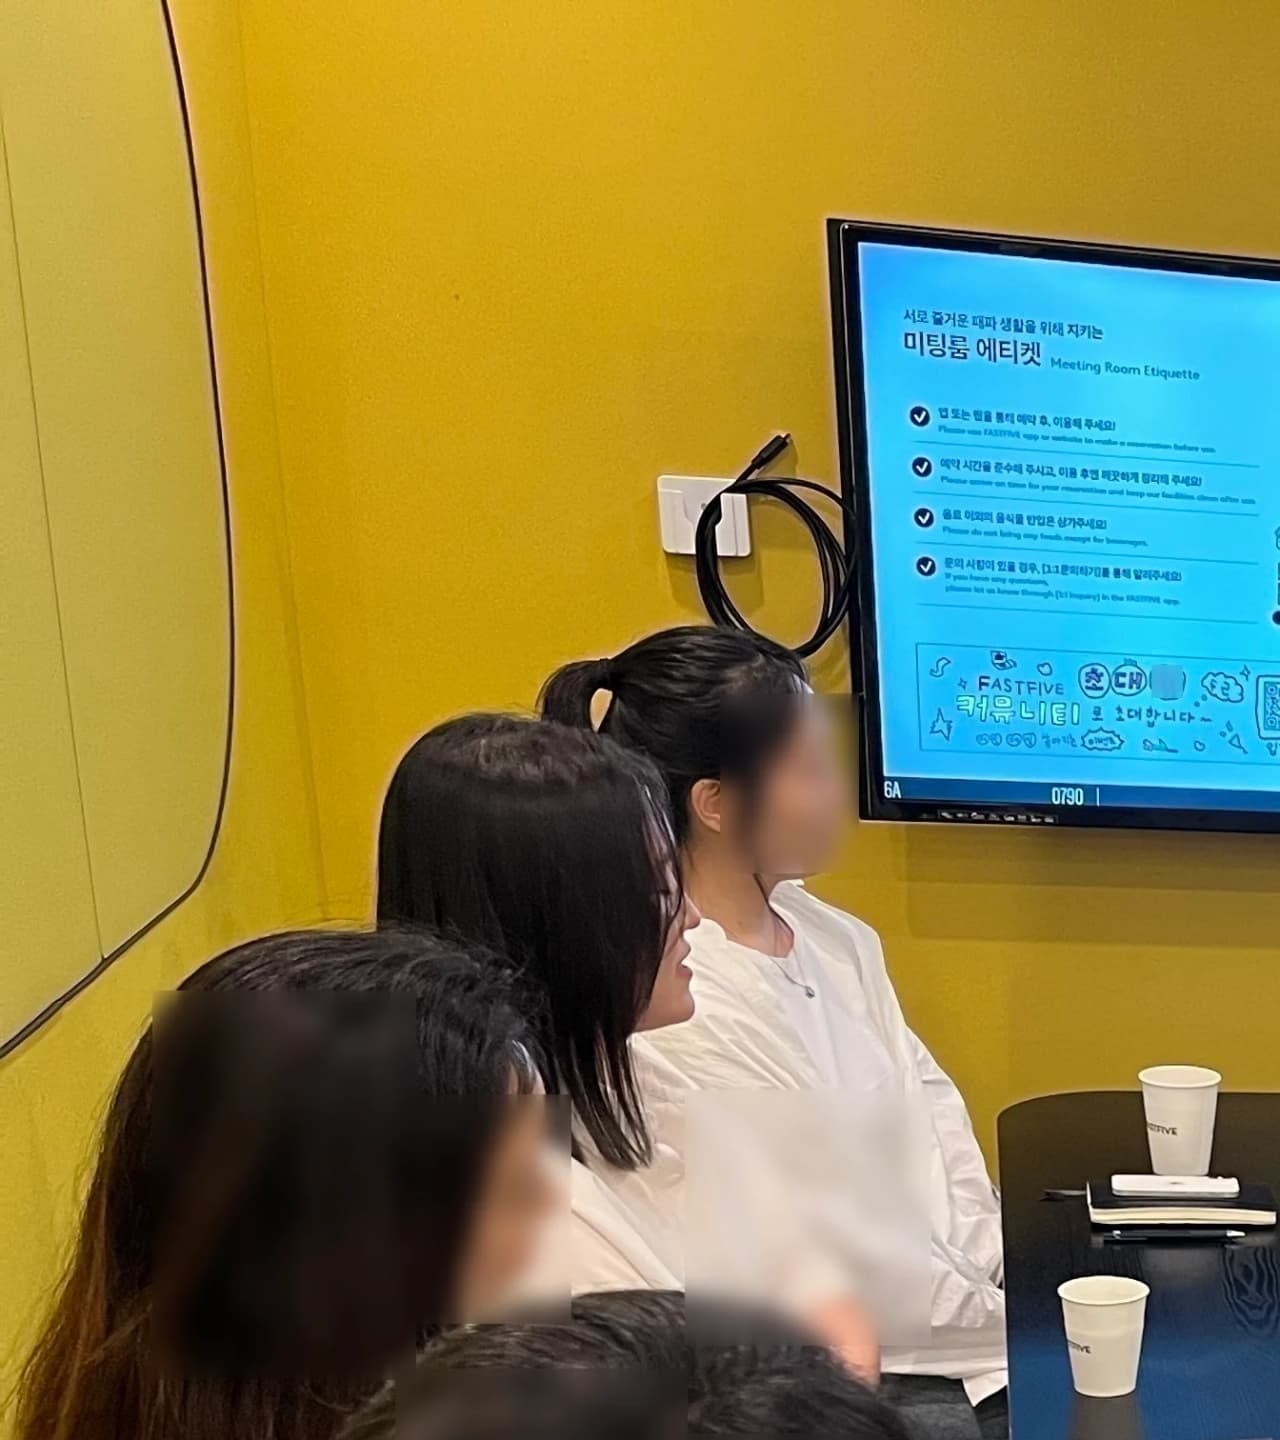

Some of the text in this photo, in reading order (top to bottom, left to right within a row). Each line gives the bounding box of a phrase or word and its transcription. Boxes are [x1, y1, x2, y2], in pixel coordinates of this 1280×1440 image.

[904, 309, 928, 323] 서로
[932, 311, 968, 328] 즐거운
[1000, 317, 1036, 334] 생활을
[1040, 321, 1064, 336] 위해
[1067, 323, 1103, 340] 지키는
[904, 331, 1041, 366] 미팅룸 에티켓
[1050, 357, 1200, 380] Meeting Room Etiquette
[978, 675, 1064, 696] FASTFIVE
[957, 694, 1080, 726] 커뮤니티
[1051, 787, 1084, 805] 0790
